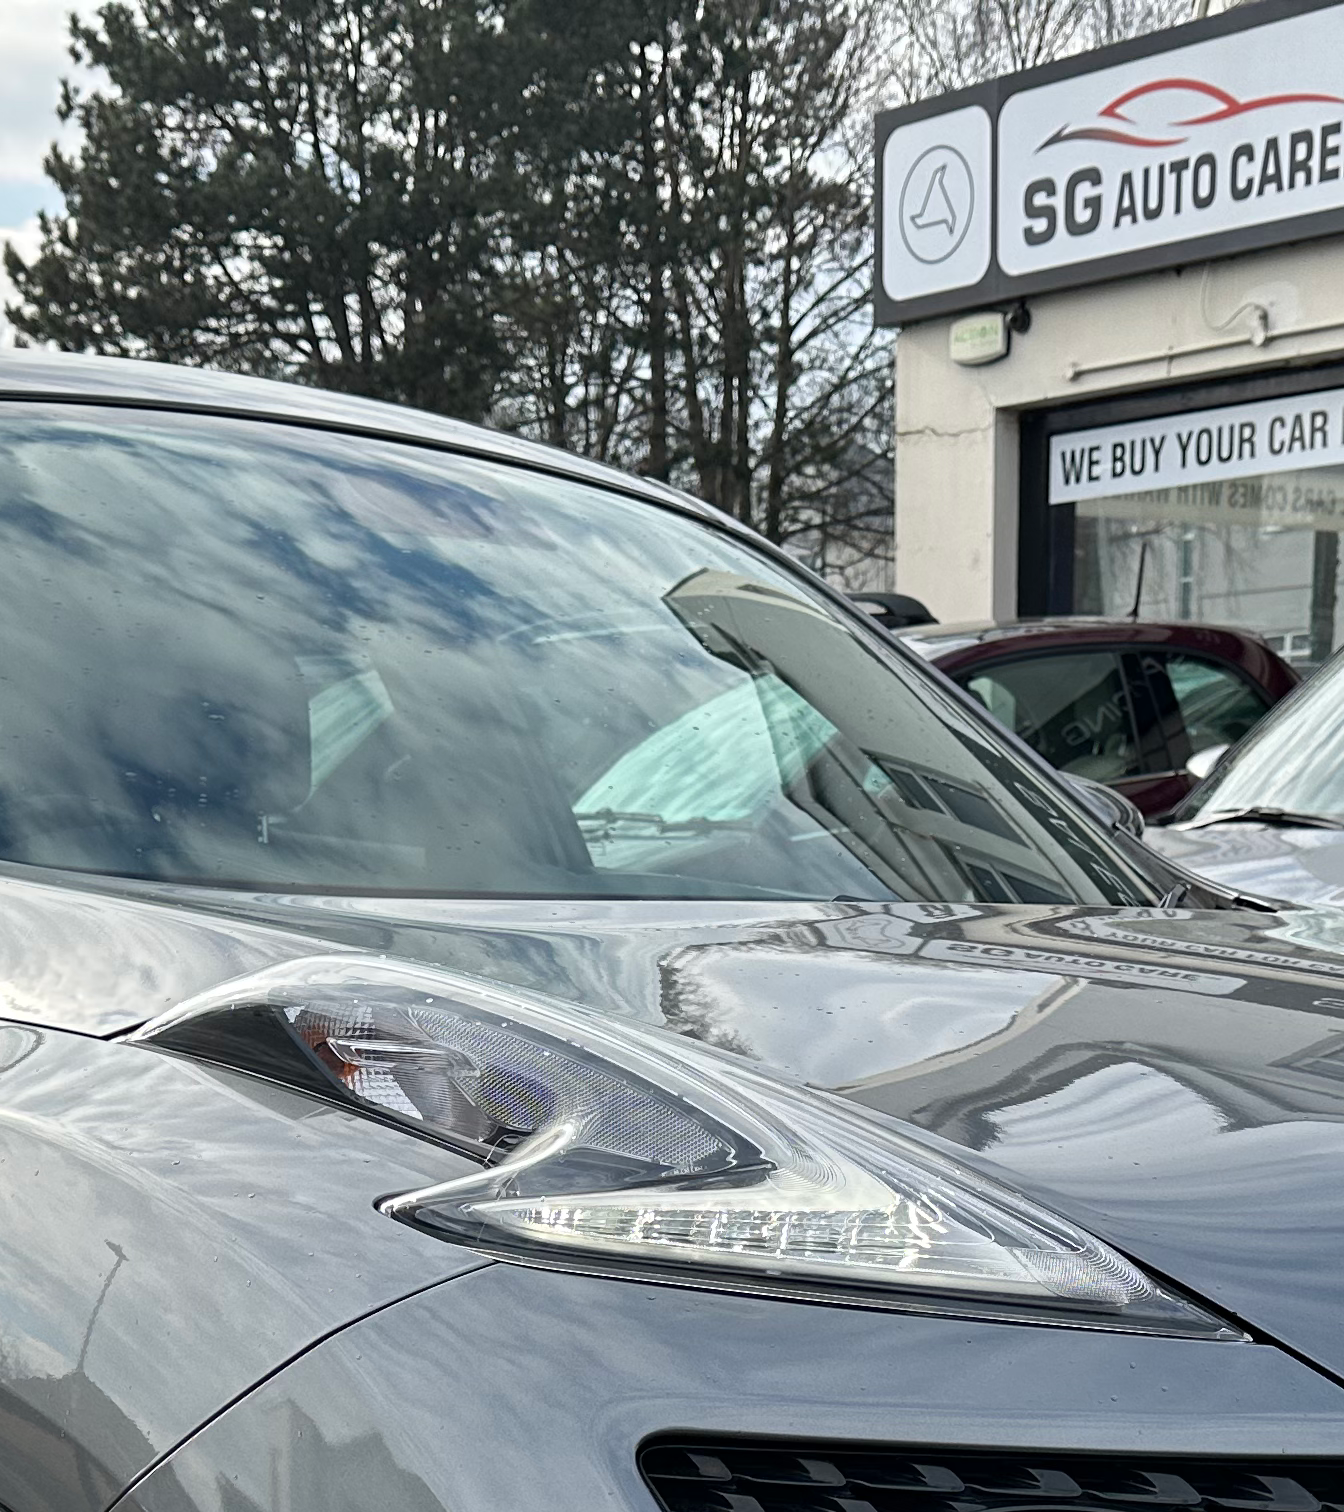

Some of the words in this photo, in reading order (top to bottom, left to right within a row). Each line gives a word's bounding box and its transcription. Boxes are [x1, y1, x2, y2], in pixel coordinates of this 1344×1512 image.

[1022, 165, 1103, 246] SG
[1112, 152, 1217, 229] AUTO
[1230, 120, 1343, 201] CARE
[1061, 445, 1101, 486] WE
[1112, 434, 1167, 479] BUY
[1175, 421, 1256, 469] YOUR
[1268, 409, 1329, 456] CAR
